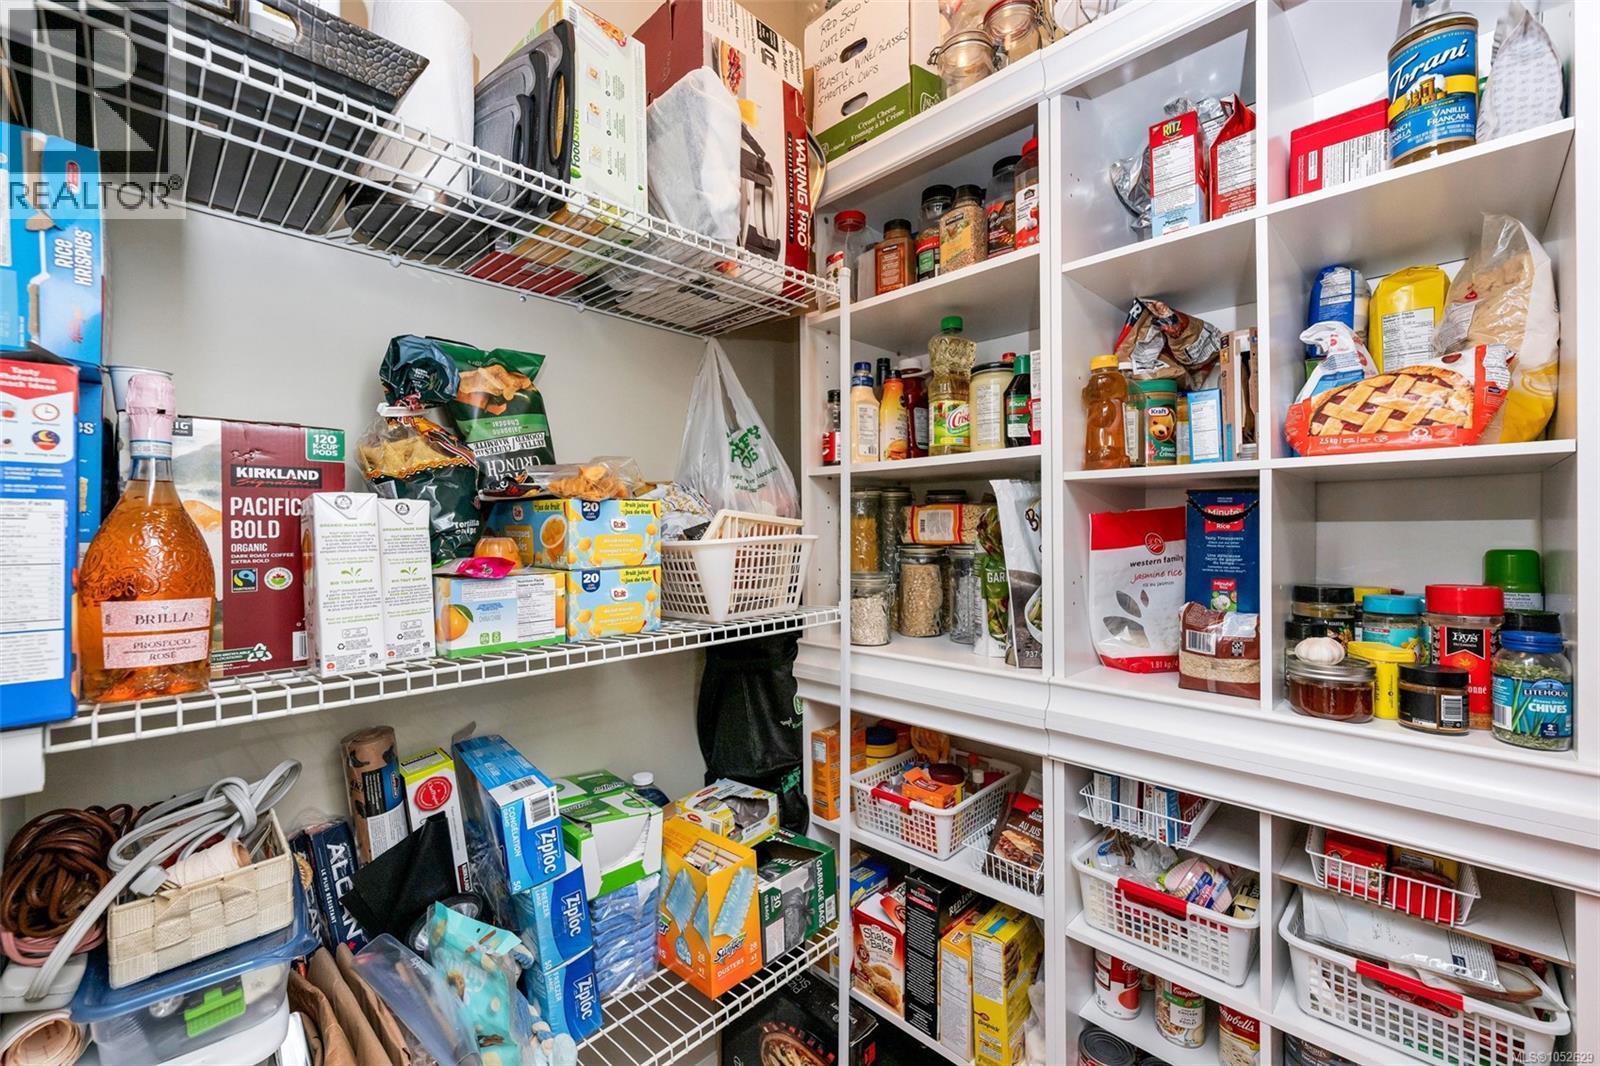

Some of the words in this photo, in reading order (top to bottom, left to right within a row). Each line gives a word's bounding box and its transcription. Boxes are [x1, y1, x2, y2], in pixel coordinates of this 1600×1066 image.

[819, 18, 838, 36] RED
[819, 18, 857, 52] CUTLERY
[1389, 38, 1468, 104] Torani
[817, 67, 849, 94] PLASTIC
[818, 78, 855, 108] SHOOTER
[857, 65, 879, 84] CUPS
[857, 117, 876, 131] Cream
[876, 105, 897, 120] Cheese
[1427, 112, 1470, 127] FRANÇAISE
[1432, 106, 1466, 117] VANILLE
[850, 125, 874, 142] Fromage
[1163, 120, 1182, 137] RITZ
[793, 138, 808, 206] WARING
[797, 209, 809, 247] PRO
[55, 238, 73, 269] RICE
[74, 228, 93, 286] KRISPIES
[313, 434, 337, 444] 120
[474, 438, 510, 450] MARMITE
[515, 433, 544, 443] COOKED
[519, 440, 545, 449] KETTLE
[313, 449, 339, 457] PODS
[236, 467, 320, 481] KIRKLAND
[485, 455, 542, 477] CRUNCH
[230, 497, 302, 516] PACIFIC
[582, 501, 599, 513] 20
[230, 520, 281, 539] BOLD
[453, 520, 480, 531] Tortilla
[231, 543, 268, 552] ORGANIC
[1130, 557, 1162, 568] western
[1163, 553, 1184, 564] family
[582, 572, 600, 583] 20
[1130, 570, 1165, 584] jasmine
[1167, 568, 1183, 577] rice
[133, 638, 191, 649] PROSECCO
[149, 650, 177, 660] ROSÉ
[1528, 703, 1567, 713] CHIVES
[1018, 820, 1030, 830] AU
[1030, 824, 1041, 837] JUS
[537, 829, 557, 874] Ziploc
[512, 879, 522, 891] 50
[816, 859, 825, 903] GARBAGE
[326, 892, 337, 924] RÉSISTANT
[773, 893, 782, 909] 30
[563, 892, 582, 937] Ziploc
[817, 903, 826, 928] BAGS
[863, 927, 894, 947] Shake
[714, 937, 744, 962] Swiffer
[869, 938, 893, 955] Bake
[716, 957, 745, 977] DUSTERS
[574, 975, 593, 1020] Ziploc
